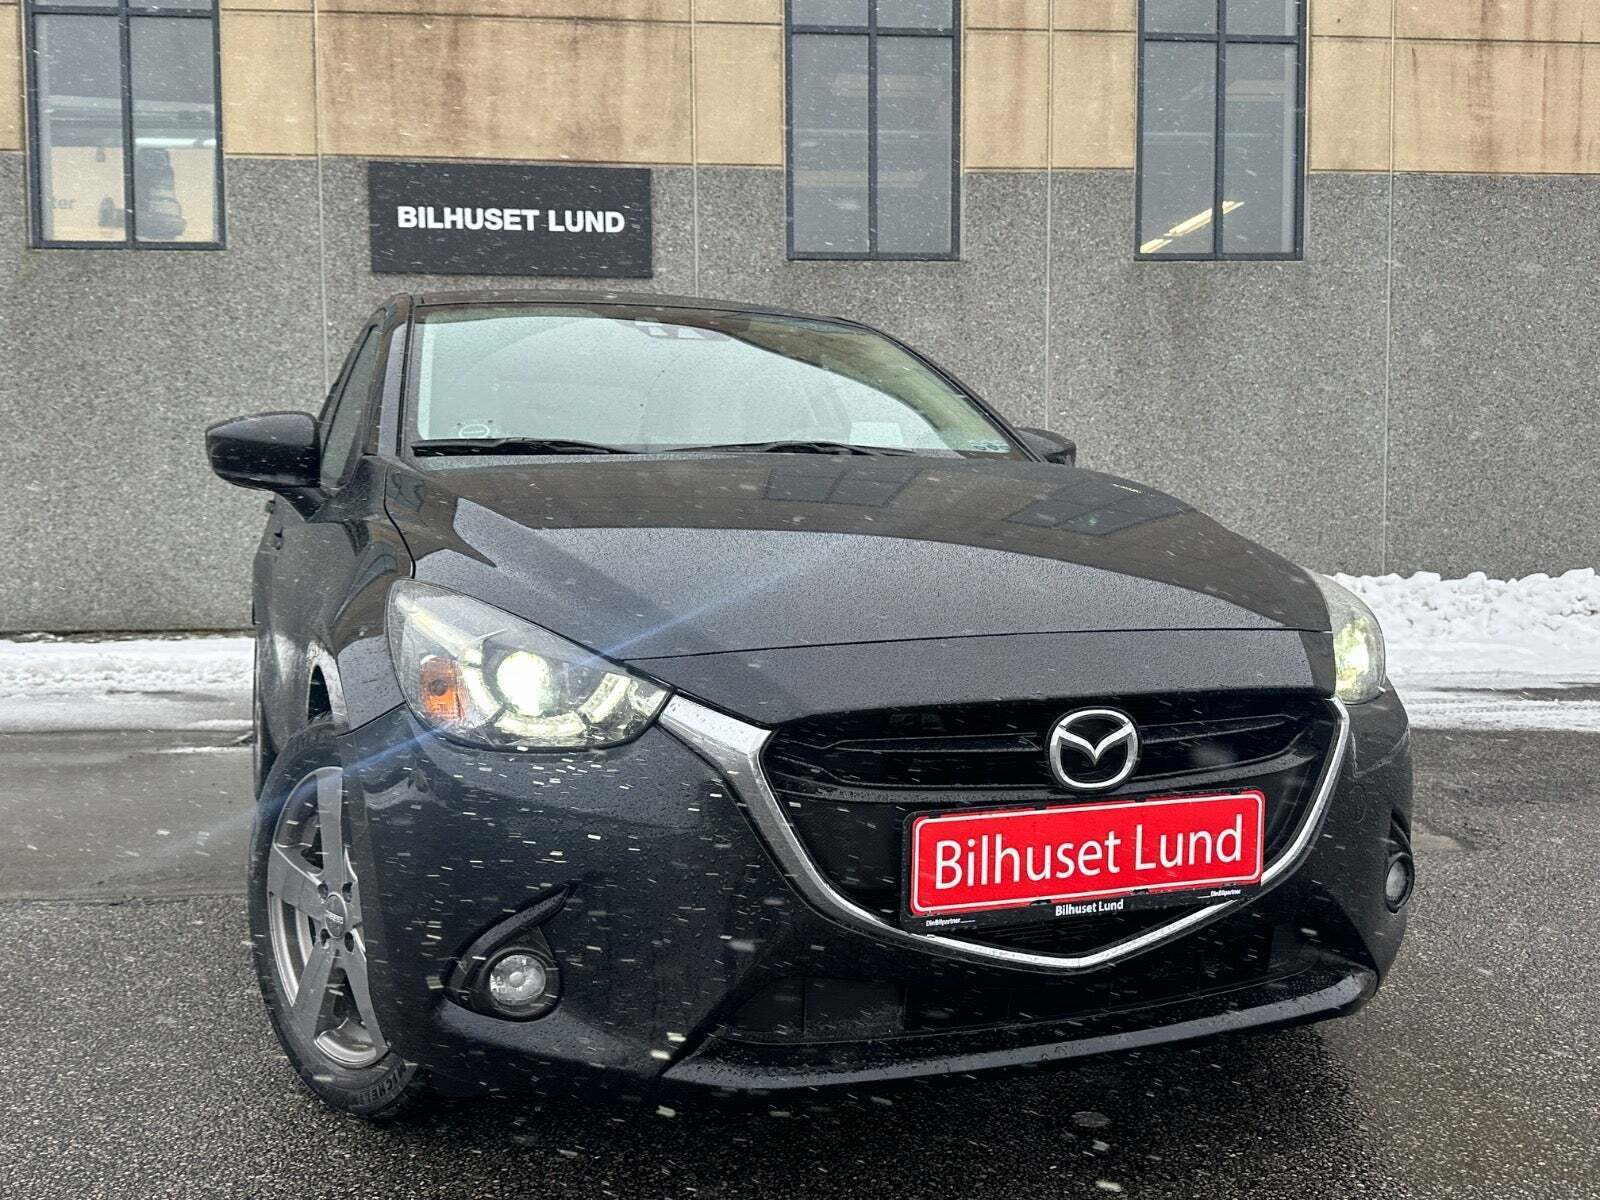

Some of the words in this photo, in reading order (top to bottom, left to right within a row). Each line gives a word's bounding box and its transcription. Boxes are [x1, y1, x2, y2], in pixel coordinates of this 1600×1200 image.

[397, 205, 540, 232] BILHUSET
[548, 209, 626, 233] LUND
[934, 830, 1122, 890] Bilhuset
[1134, 813, 1243, 871] Lund
[1055, 902, 1097, 917] Bilhuset
[1098, 898, 1124, 912] Lund
